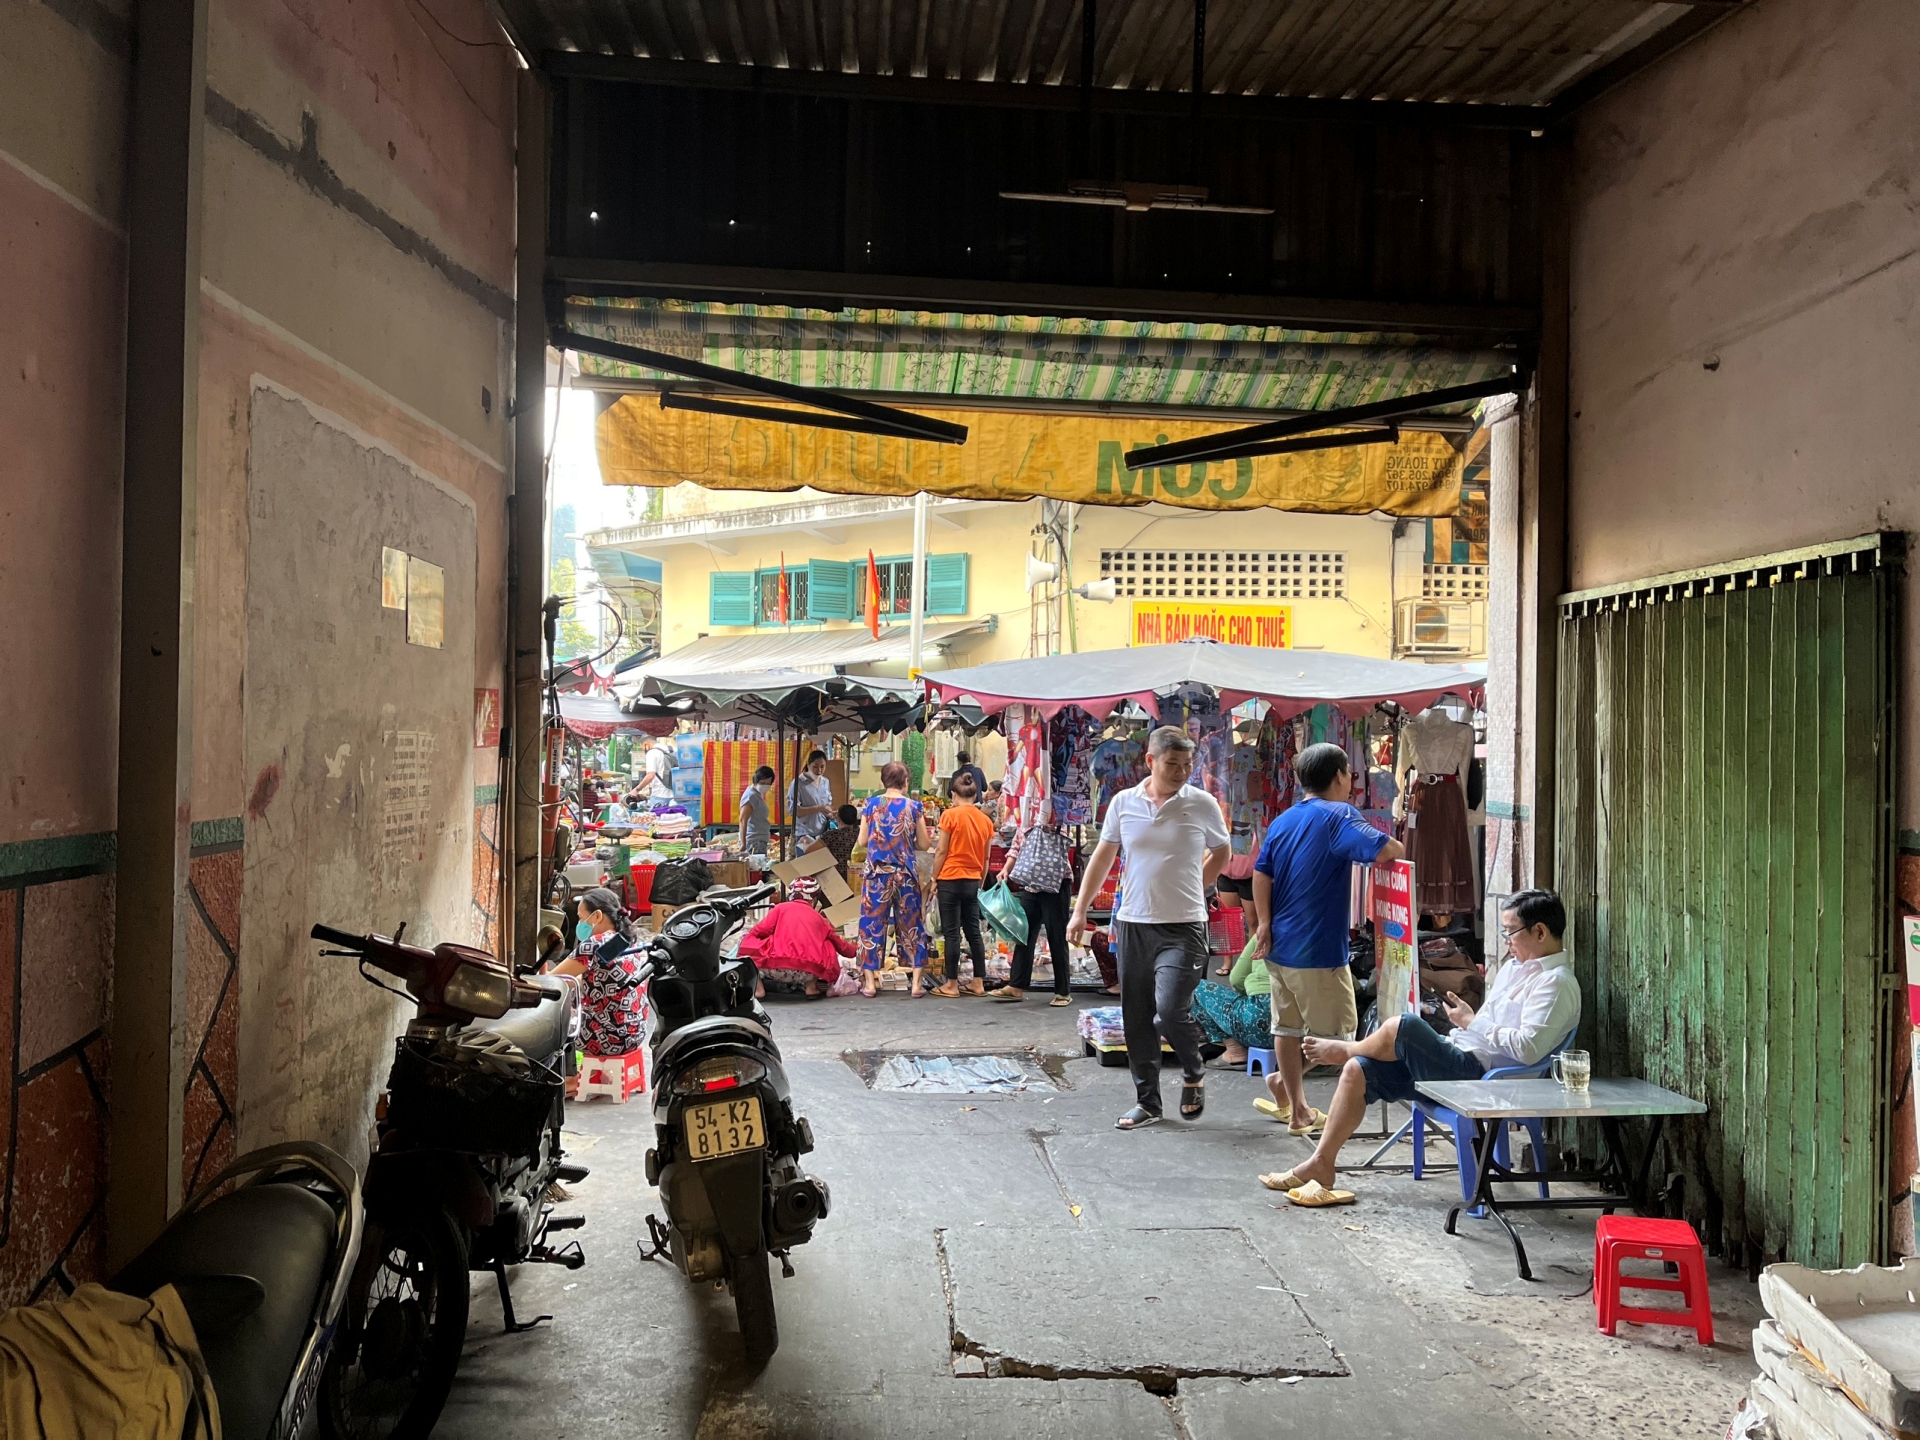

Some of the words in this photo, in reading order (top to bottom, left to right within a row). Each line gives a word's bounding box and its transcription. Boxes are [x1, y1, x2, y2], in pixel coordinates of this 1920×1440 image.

[1137, 606, 1162, 644] NHÀ
[1165, 607, 1190, 644] BÁN
[1229, 615, 1252, 646] CHO
[1256, 610, 1286, 648] THUÊ
[1375, 864, 1390, 888] BÁNH
[1391, 866, 1408, 893] CUỐN
[1391, 903, 1409, 926] KONG
[695, 1101, 751, 1129] 54-K2
[698, 1125, 755, 1154] 8132
